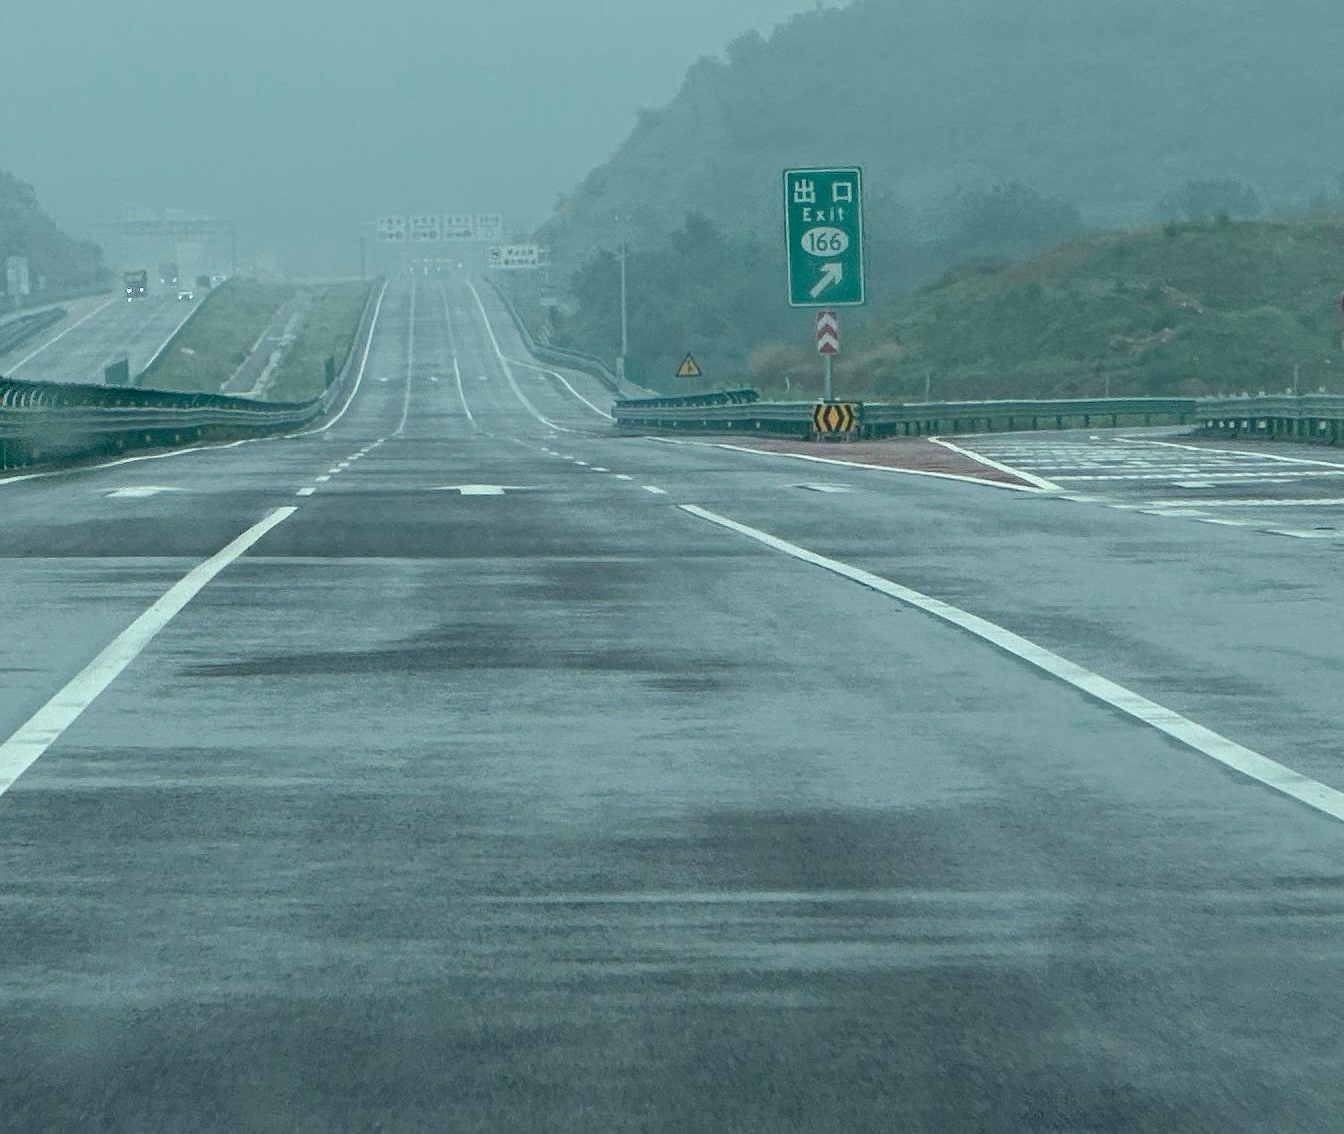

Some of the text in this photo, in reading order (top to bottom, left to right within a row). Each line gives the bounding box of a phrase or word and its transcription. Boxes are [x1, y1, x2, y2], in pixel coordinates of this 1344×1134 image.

[793, 179, 852, 203] 出口
[802, 206, 844, 222] Exit
[808, 232, 842, 251] 166
